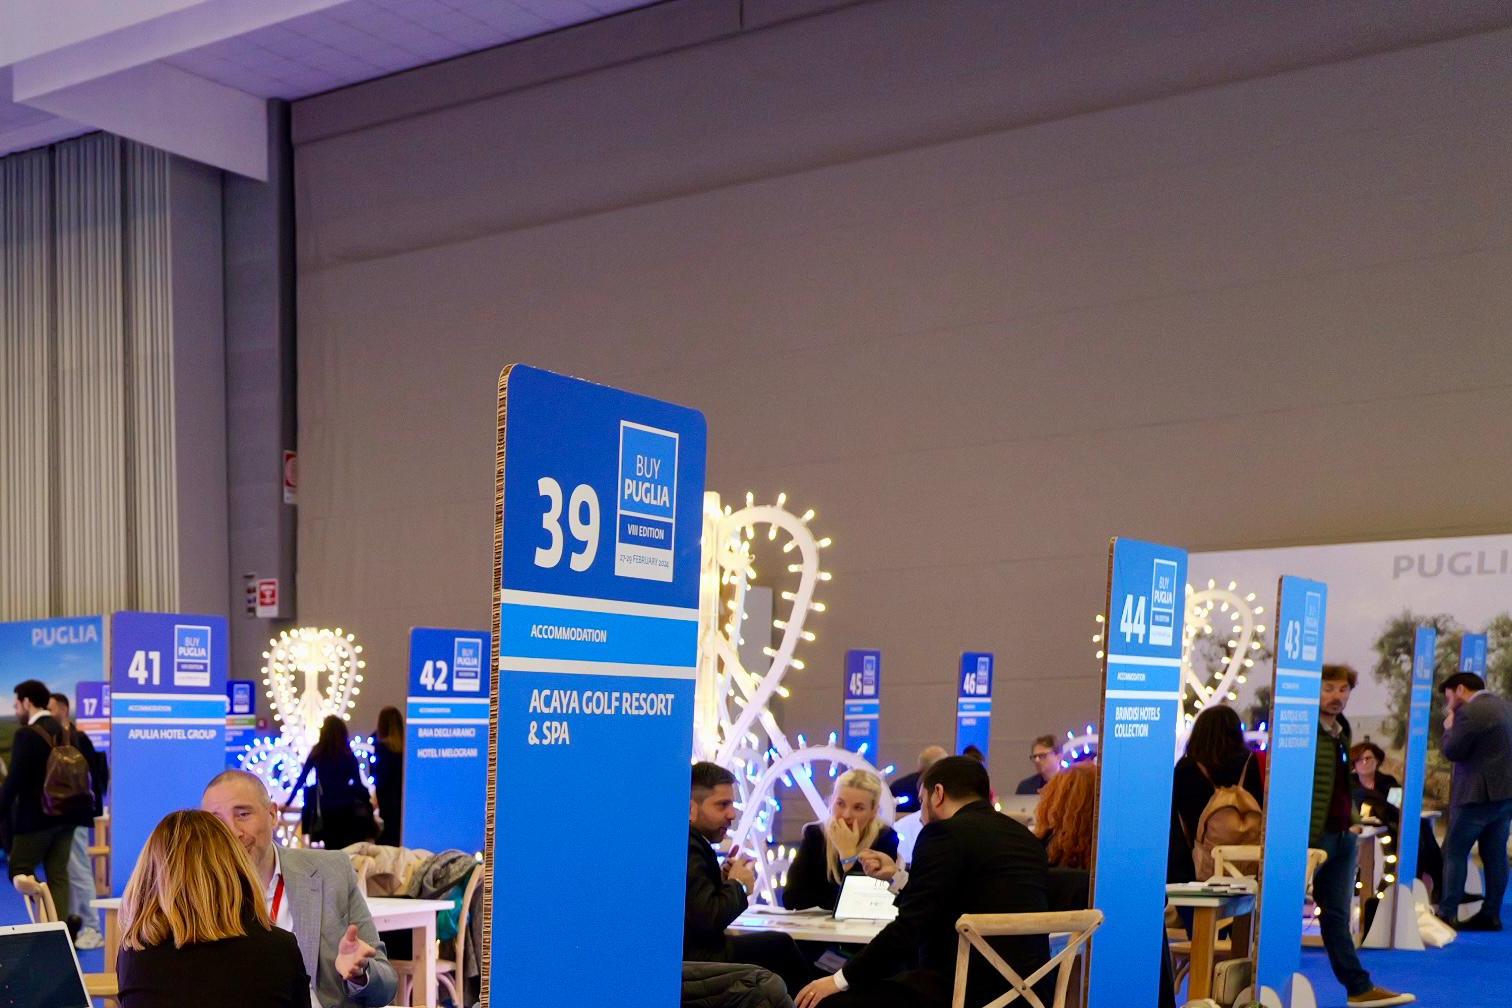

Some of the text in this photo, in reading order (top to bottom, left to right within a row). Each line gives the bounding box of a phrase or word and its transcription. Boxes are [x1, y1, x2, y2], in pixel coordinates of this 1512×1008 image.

[636, 454, 661, 479] BUY
[624, 478, 670, 508] PUGLIA
[534, 476, 601, 573] 39
[627, 523, 665, 541] VIII EDITION
[1392, 548, 1512, 580] PUGLI
[1154, 589, 1173, 605] PUGLIA
[1120, 594, 1147, 645] 44
[31, 624, 98, 646] PUGLIA
[530, 624, 607, 644] ACCOMMODATION
[1284, 619, 1301, 661] 43
[178, 646, 207, 657] PUGLIA
[128, 650, 161, 685] 41
[419, 660, 448, 691] 42
[850, 673, 862, 695] 45
[963, 672, 976, 695] 46
[83, 698, 98, 716] 17
[529, 688, 675, 717] ACAYA GOLF RESORT
[1115, 706, 1161, 721] BRINDISI HOTELS
[128, 729, 160, 739] APULIA
[160, 729, 186, 740] HOTEL
[187, 729, 217, 740] GROUP
[527, 720, 570, 746] & SPA
[1114, 723, 1149, 738] COLLECTION
